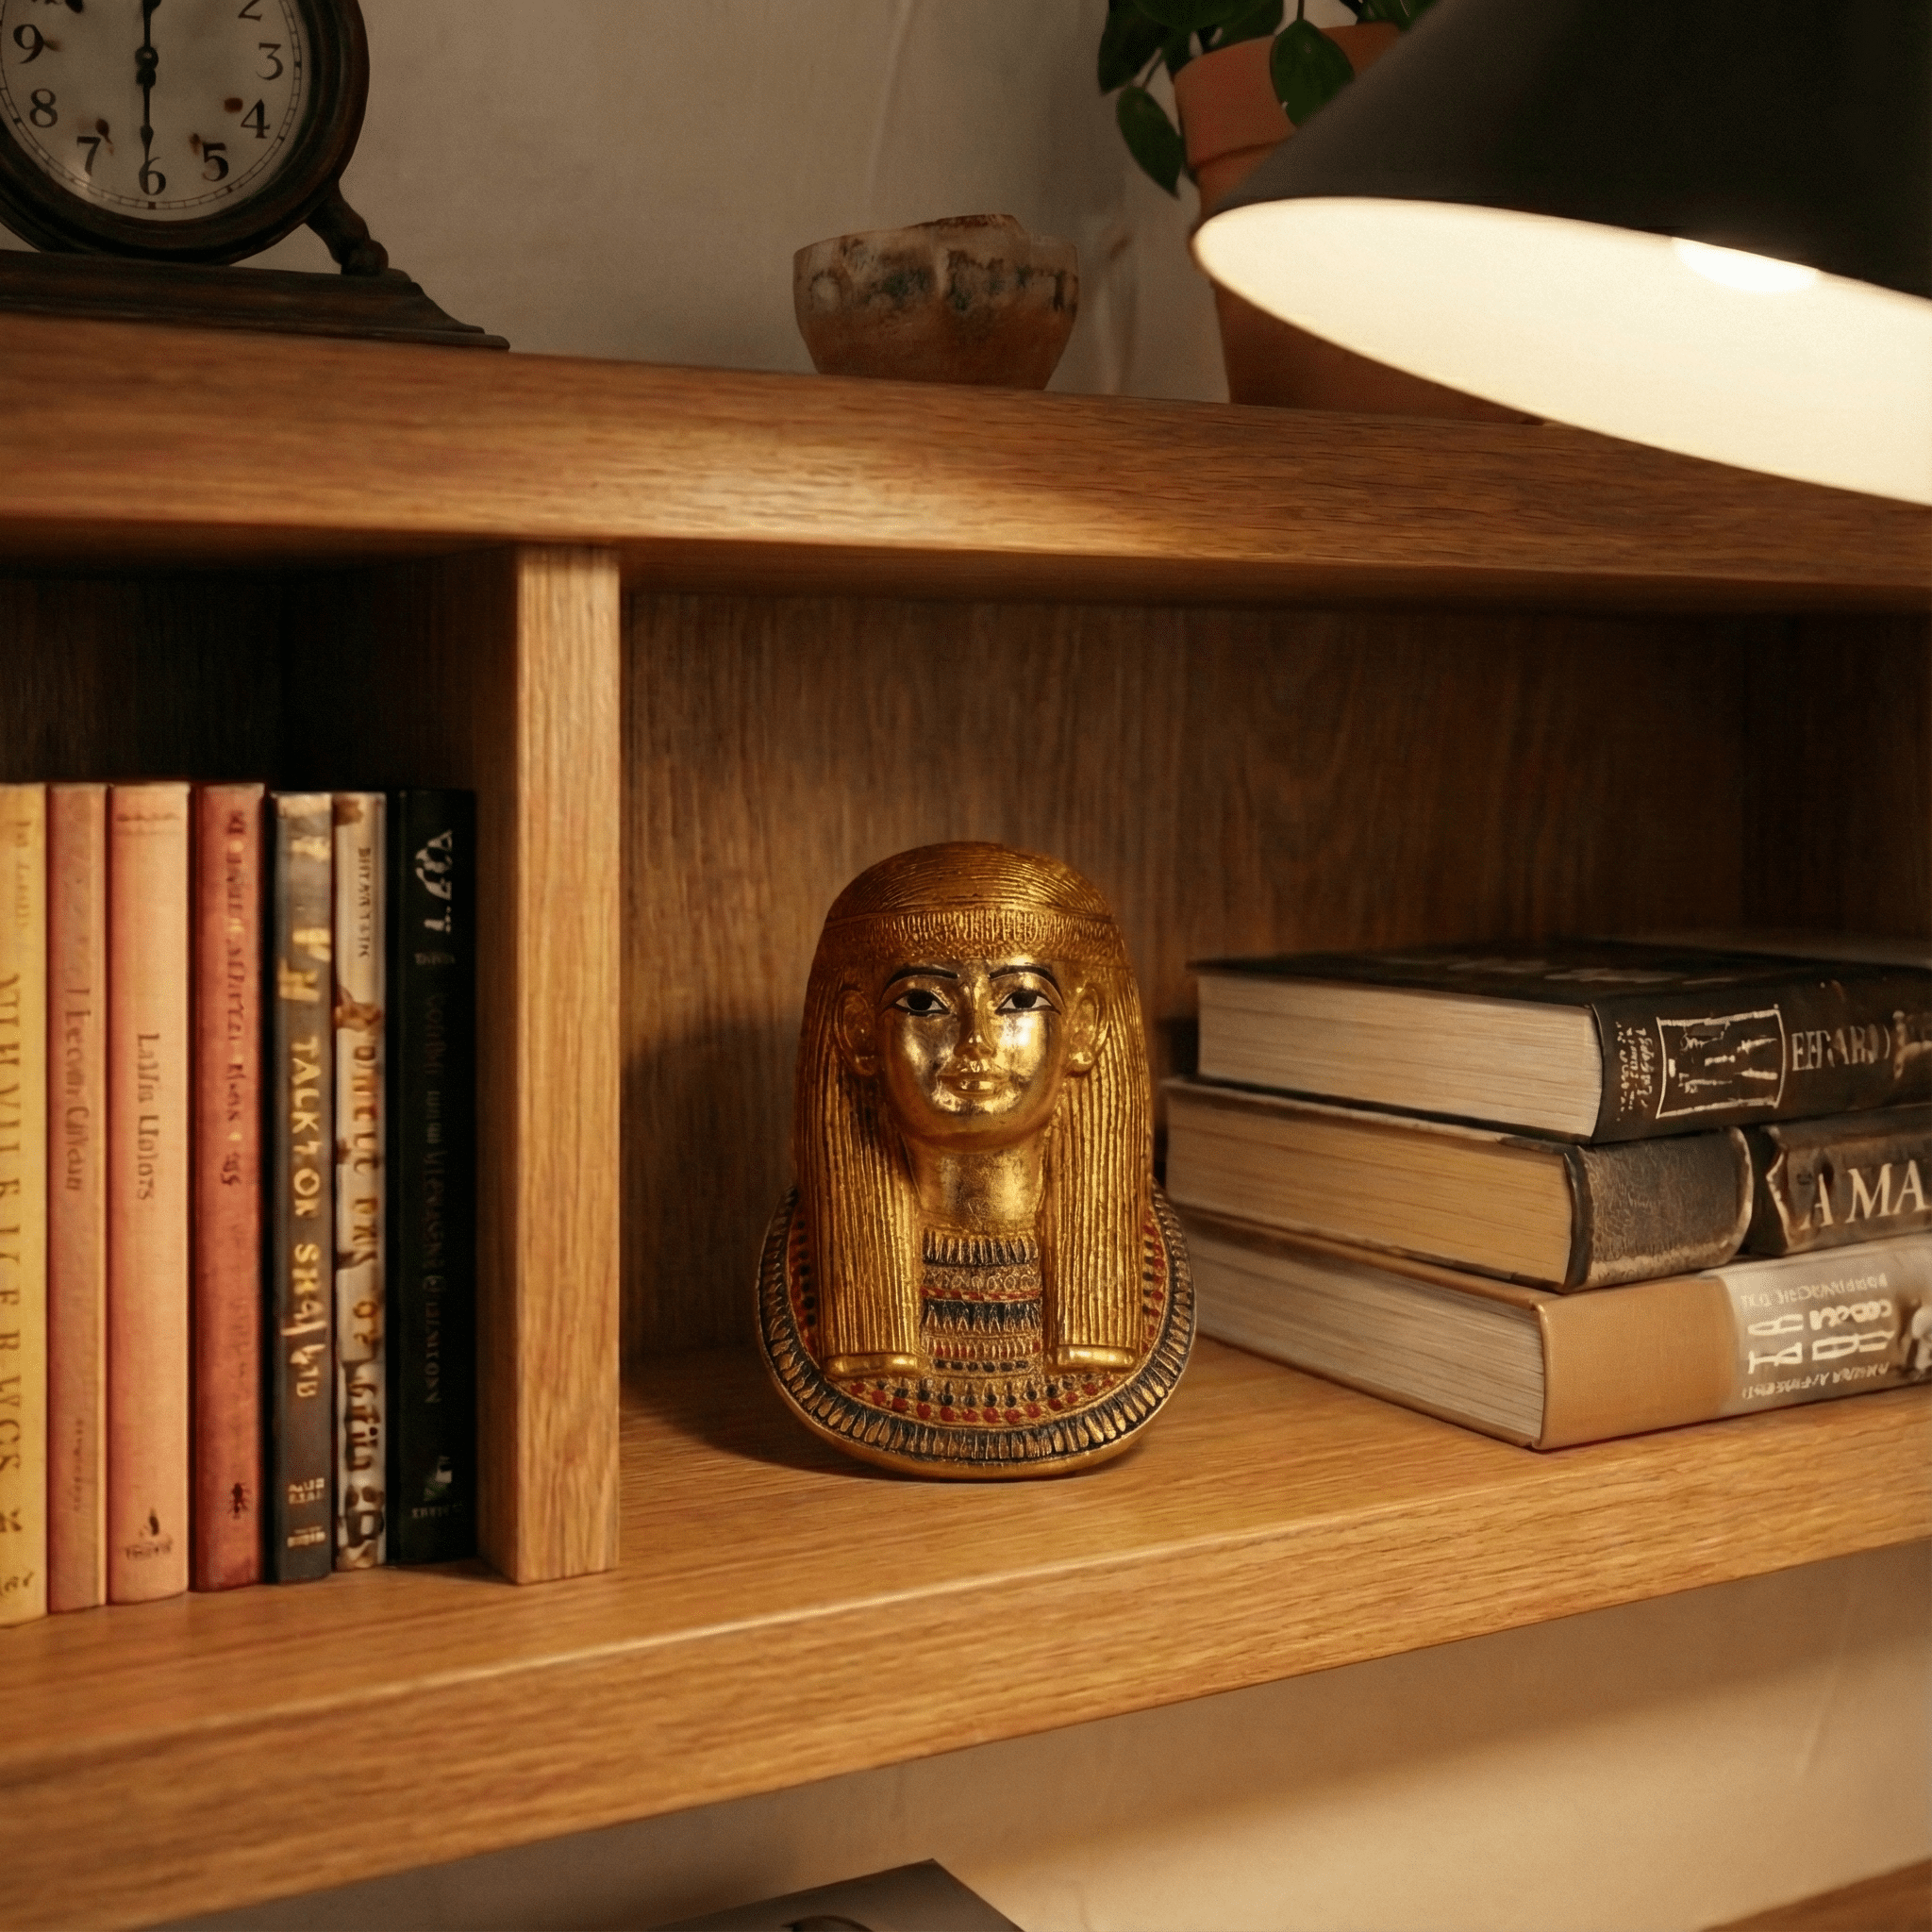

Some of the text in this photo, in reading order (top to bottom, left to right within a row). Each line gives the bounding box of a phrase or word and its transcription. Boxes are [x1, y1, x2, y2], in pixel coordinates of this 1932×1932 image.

[13, 24, 44, 64] 9
[256, 42, 284, 81] 3
[29, 89, 58, 127] 8
[240, 98, 271, 140] 4
[76, 136, 101, 176] 7
[139, 157, 166, 195] 6
[201, 142, 229, 182] 5
